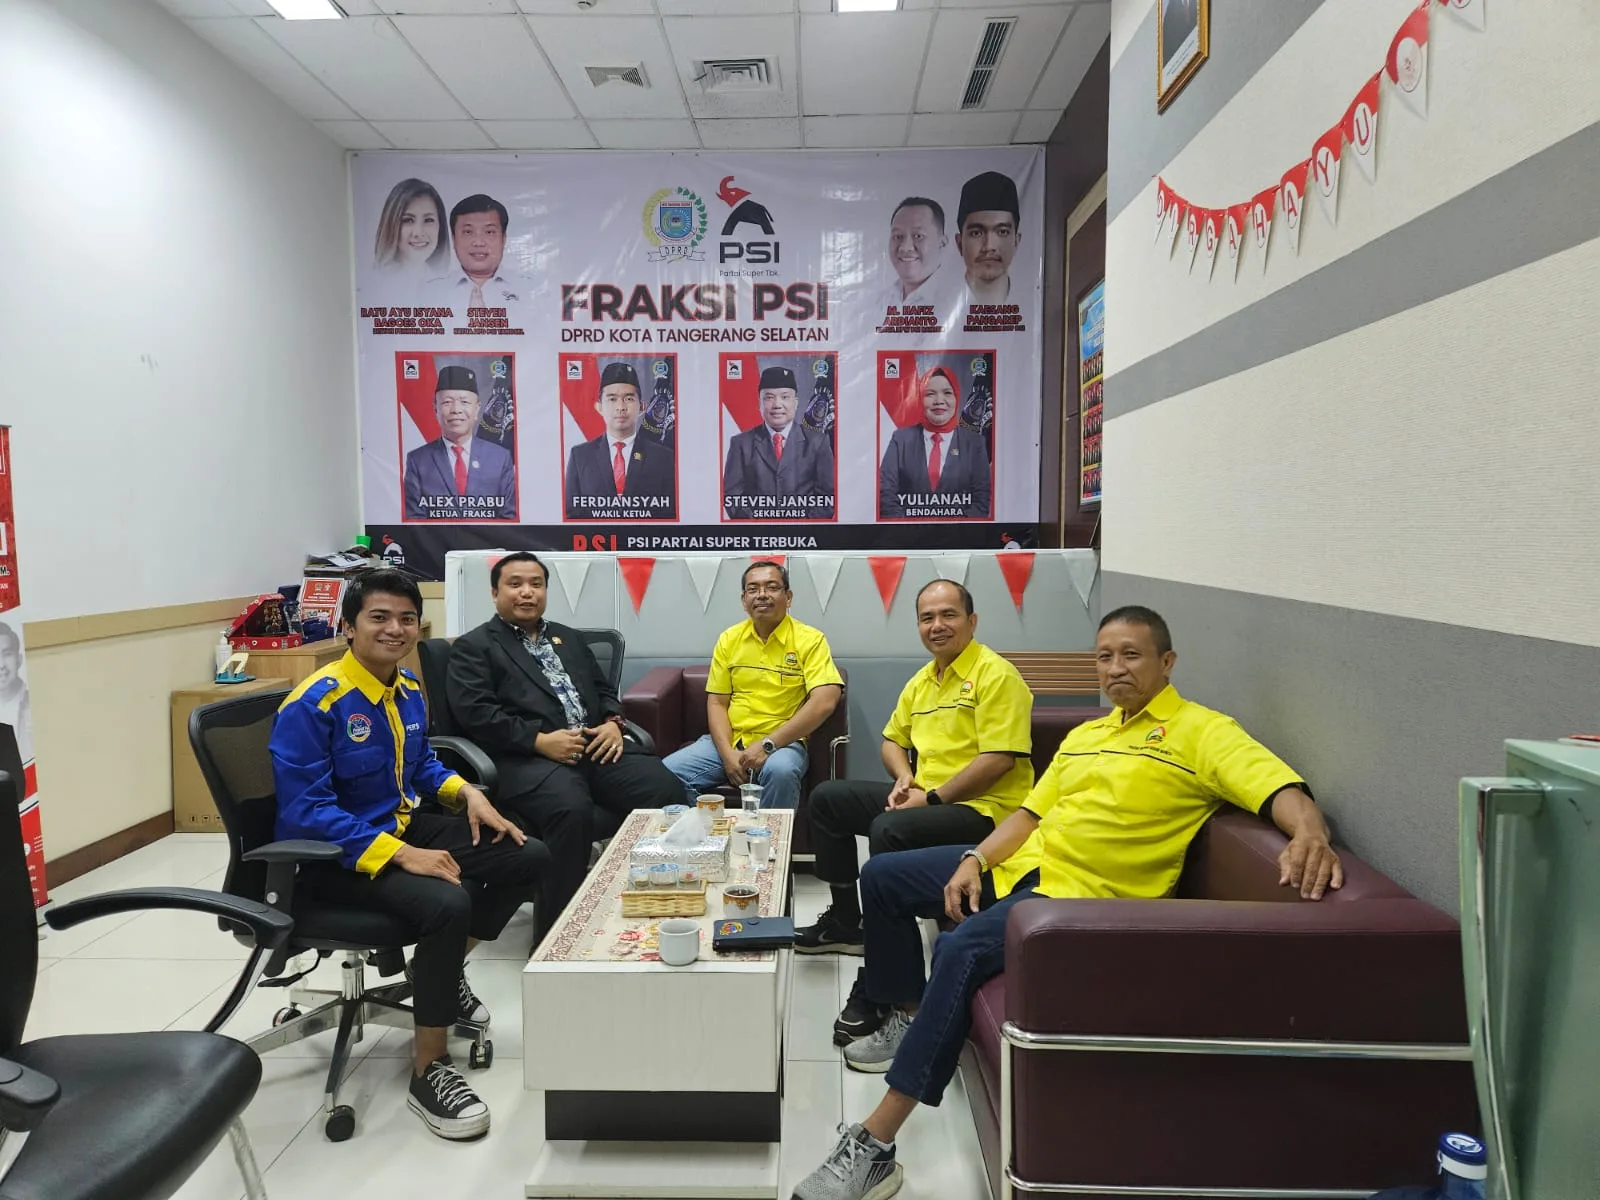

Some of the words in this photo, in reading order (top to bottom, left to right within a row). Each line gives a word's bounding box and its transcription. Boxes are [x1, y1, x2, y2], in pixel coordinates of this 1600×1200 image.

[720, 241, 780, 263] PSI
[742, 270, 764, 279] Super
[561, 283, 737, 322] FRAKSI
[752, 282, 829, 321] PSI
[388, 307, 412, 318] AYU
[467, 307, 507, 318] STEVEN
[969, 304, 1020, 315] KAESANG
[374, 318, 416, 328] BAGOES
[418, 318, 443, 328] OKA
[468, 318, 509, 328] JANSEN
[883, 316, 938, 326] ARDIANTO
[966, 314, 1023, 326] PANGAREP
[561, 328, 605, 343] DPRD
[609, 328, 653, 343] KOTA
[657, 328, 756, 343] TANGERANG
[760, 327, 829, 342] SELATAN
[419, 496, 454, 507] ALEX
[459, 496, 505, 507] PRABU
[572, 496, 670, 507] FERDIANSYAH
[724, 495, 776, 507] STEVEN
[780, 495, 835, 507] JANSEN
[897, 493, 972, 505] YULIANAH
[429, 510, 458, 518] KETUA
[463, 510, 495, 518] FRAKSI
[591, 510, 620, 518] WAKIL
[623, 510, 652, 518] KETUA
[753, 509, 806, 518] SEKRETARIS
[905, 508, 964, 516] BENDAHARA
[573, 534, 617, 551] PSI
[627, 536, 649, 548] PSI
[652, 536, 703, 548] PARTAI
[706, 536, 750, 548] SUPER
[753, 536, 818, 548] TERBUKA
